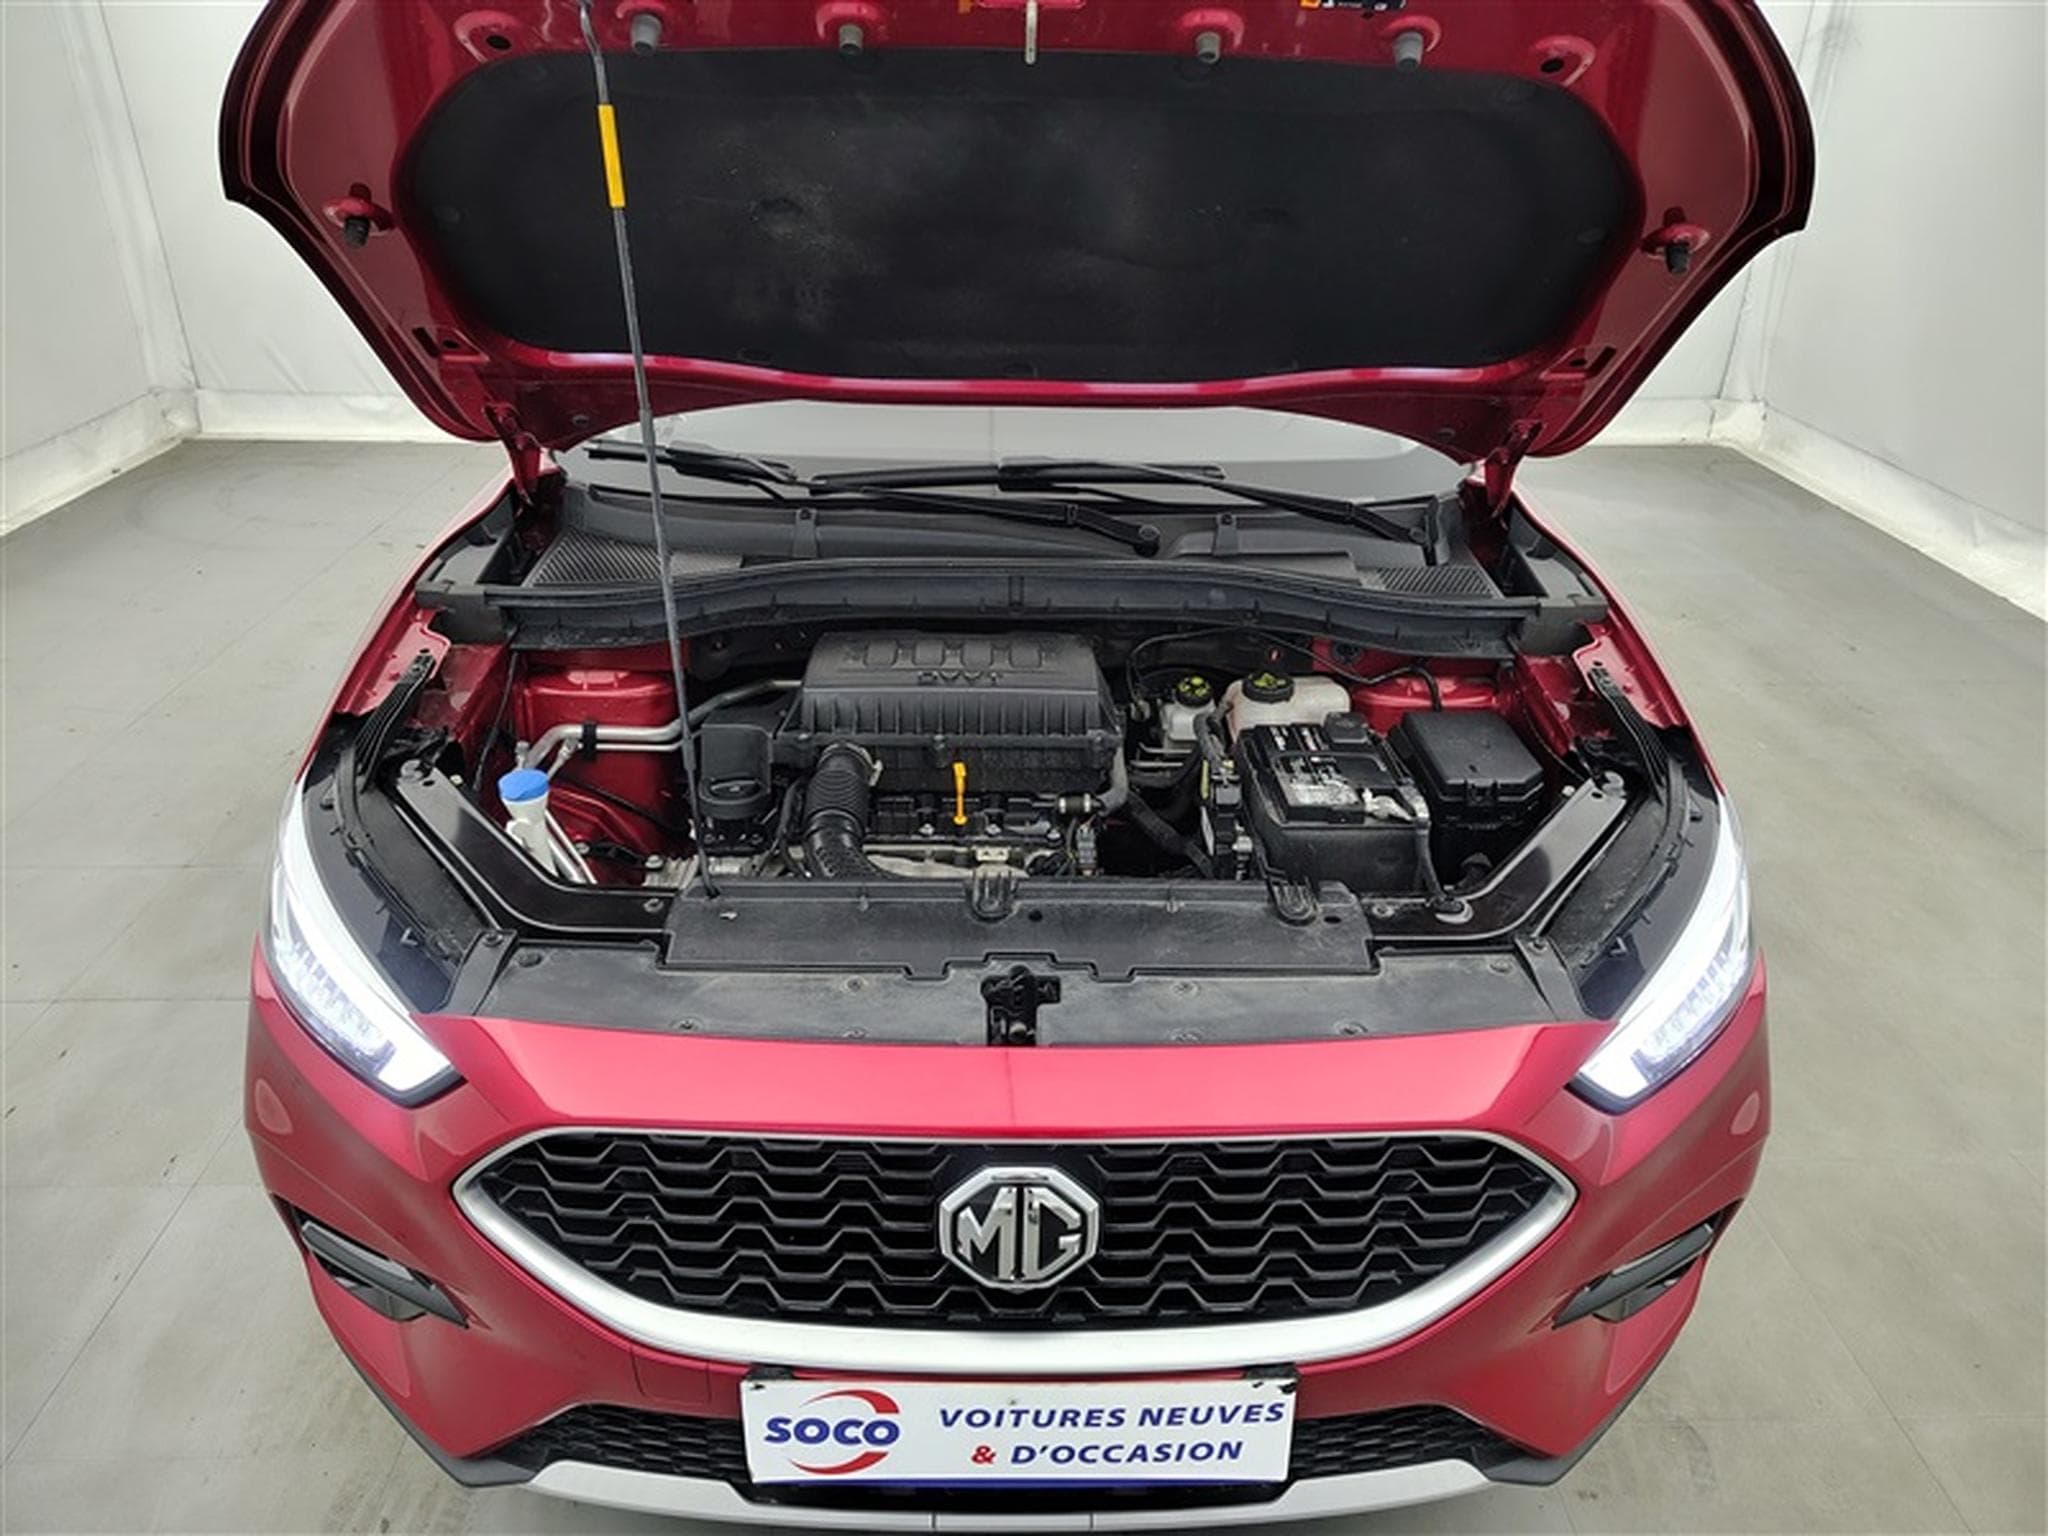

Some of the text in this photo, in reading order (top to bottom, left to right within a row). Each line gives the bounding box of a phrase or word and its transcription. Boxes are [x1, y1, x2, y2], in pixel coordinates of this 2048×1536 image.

[956, 1186, 1081, 1280] MG
[940, 1403, 1285, 1428] VOITURES NEUVES
[764, 1416, 900, 1446] SOCO
[971, 1441, 1243, 1464] & D'OCCASION
